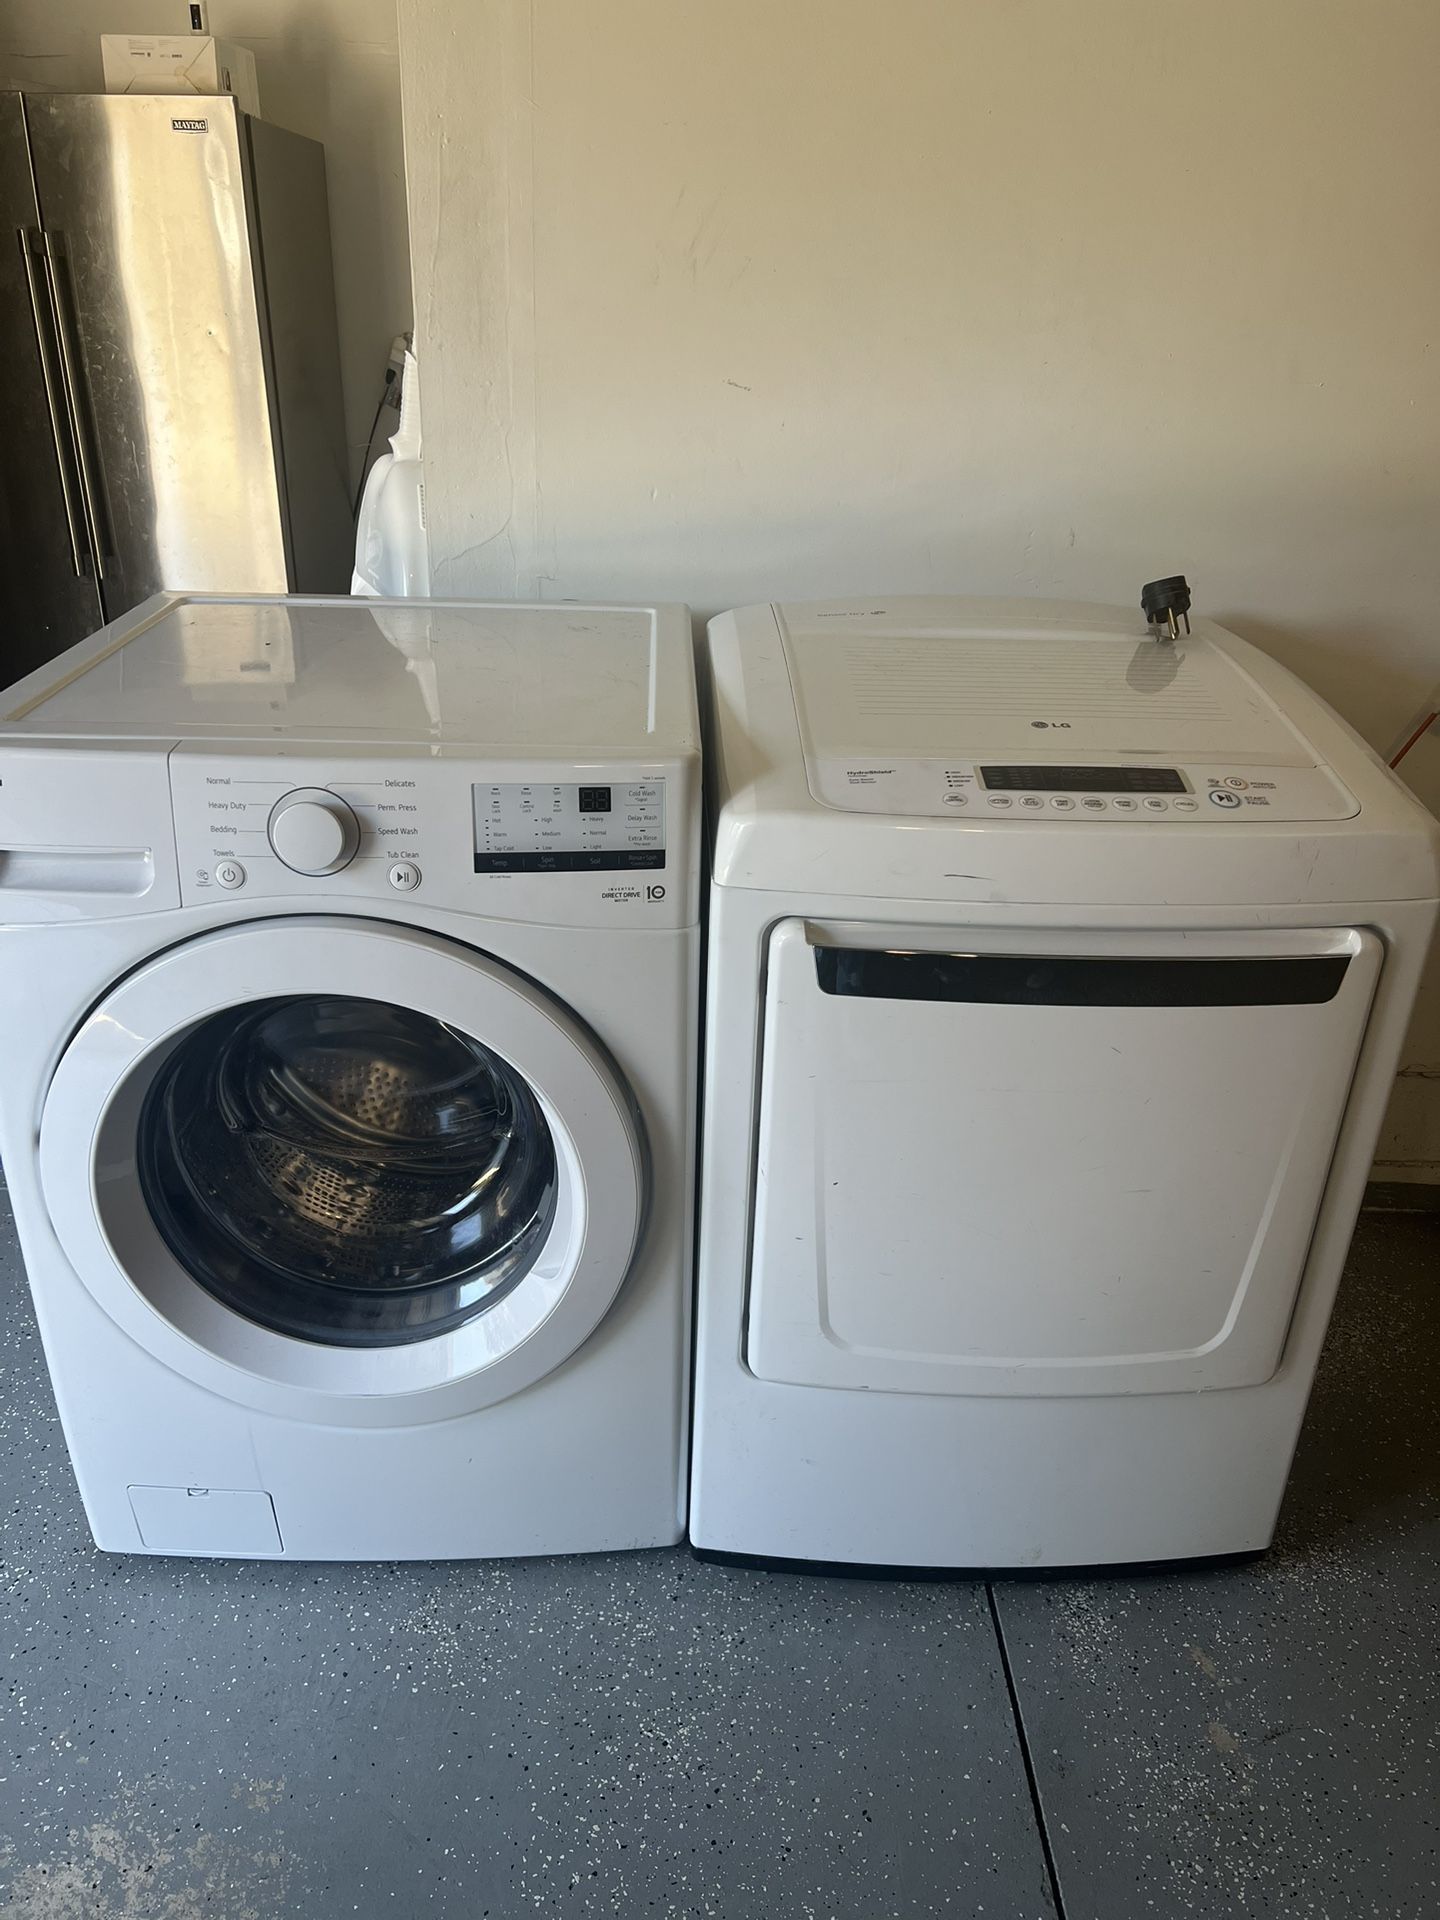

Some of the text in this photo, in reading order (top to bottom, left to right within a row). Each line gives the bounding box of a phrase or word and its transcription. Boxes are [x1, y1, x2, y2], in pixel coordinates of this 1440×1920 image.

[173, 121, 206, 130] MAYTAG
[206, 777, 231, 785] Normal
[385, 780, 416, 788] Delicates
[208, 802, 247, 811] Heavy Duty
[399, 804, 417, 812] Press
[210, 826, 237, 834] Bedding
[377, 828, 397, 836] Speed
[401, 851, 419, 859] Clean
[491, 859, 508, 867] Temp
[590, 857, 601, 865] Soil
[646, 885, 666, 900] 10
